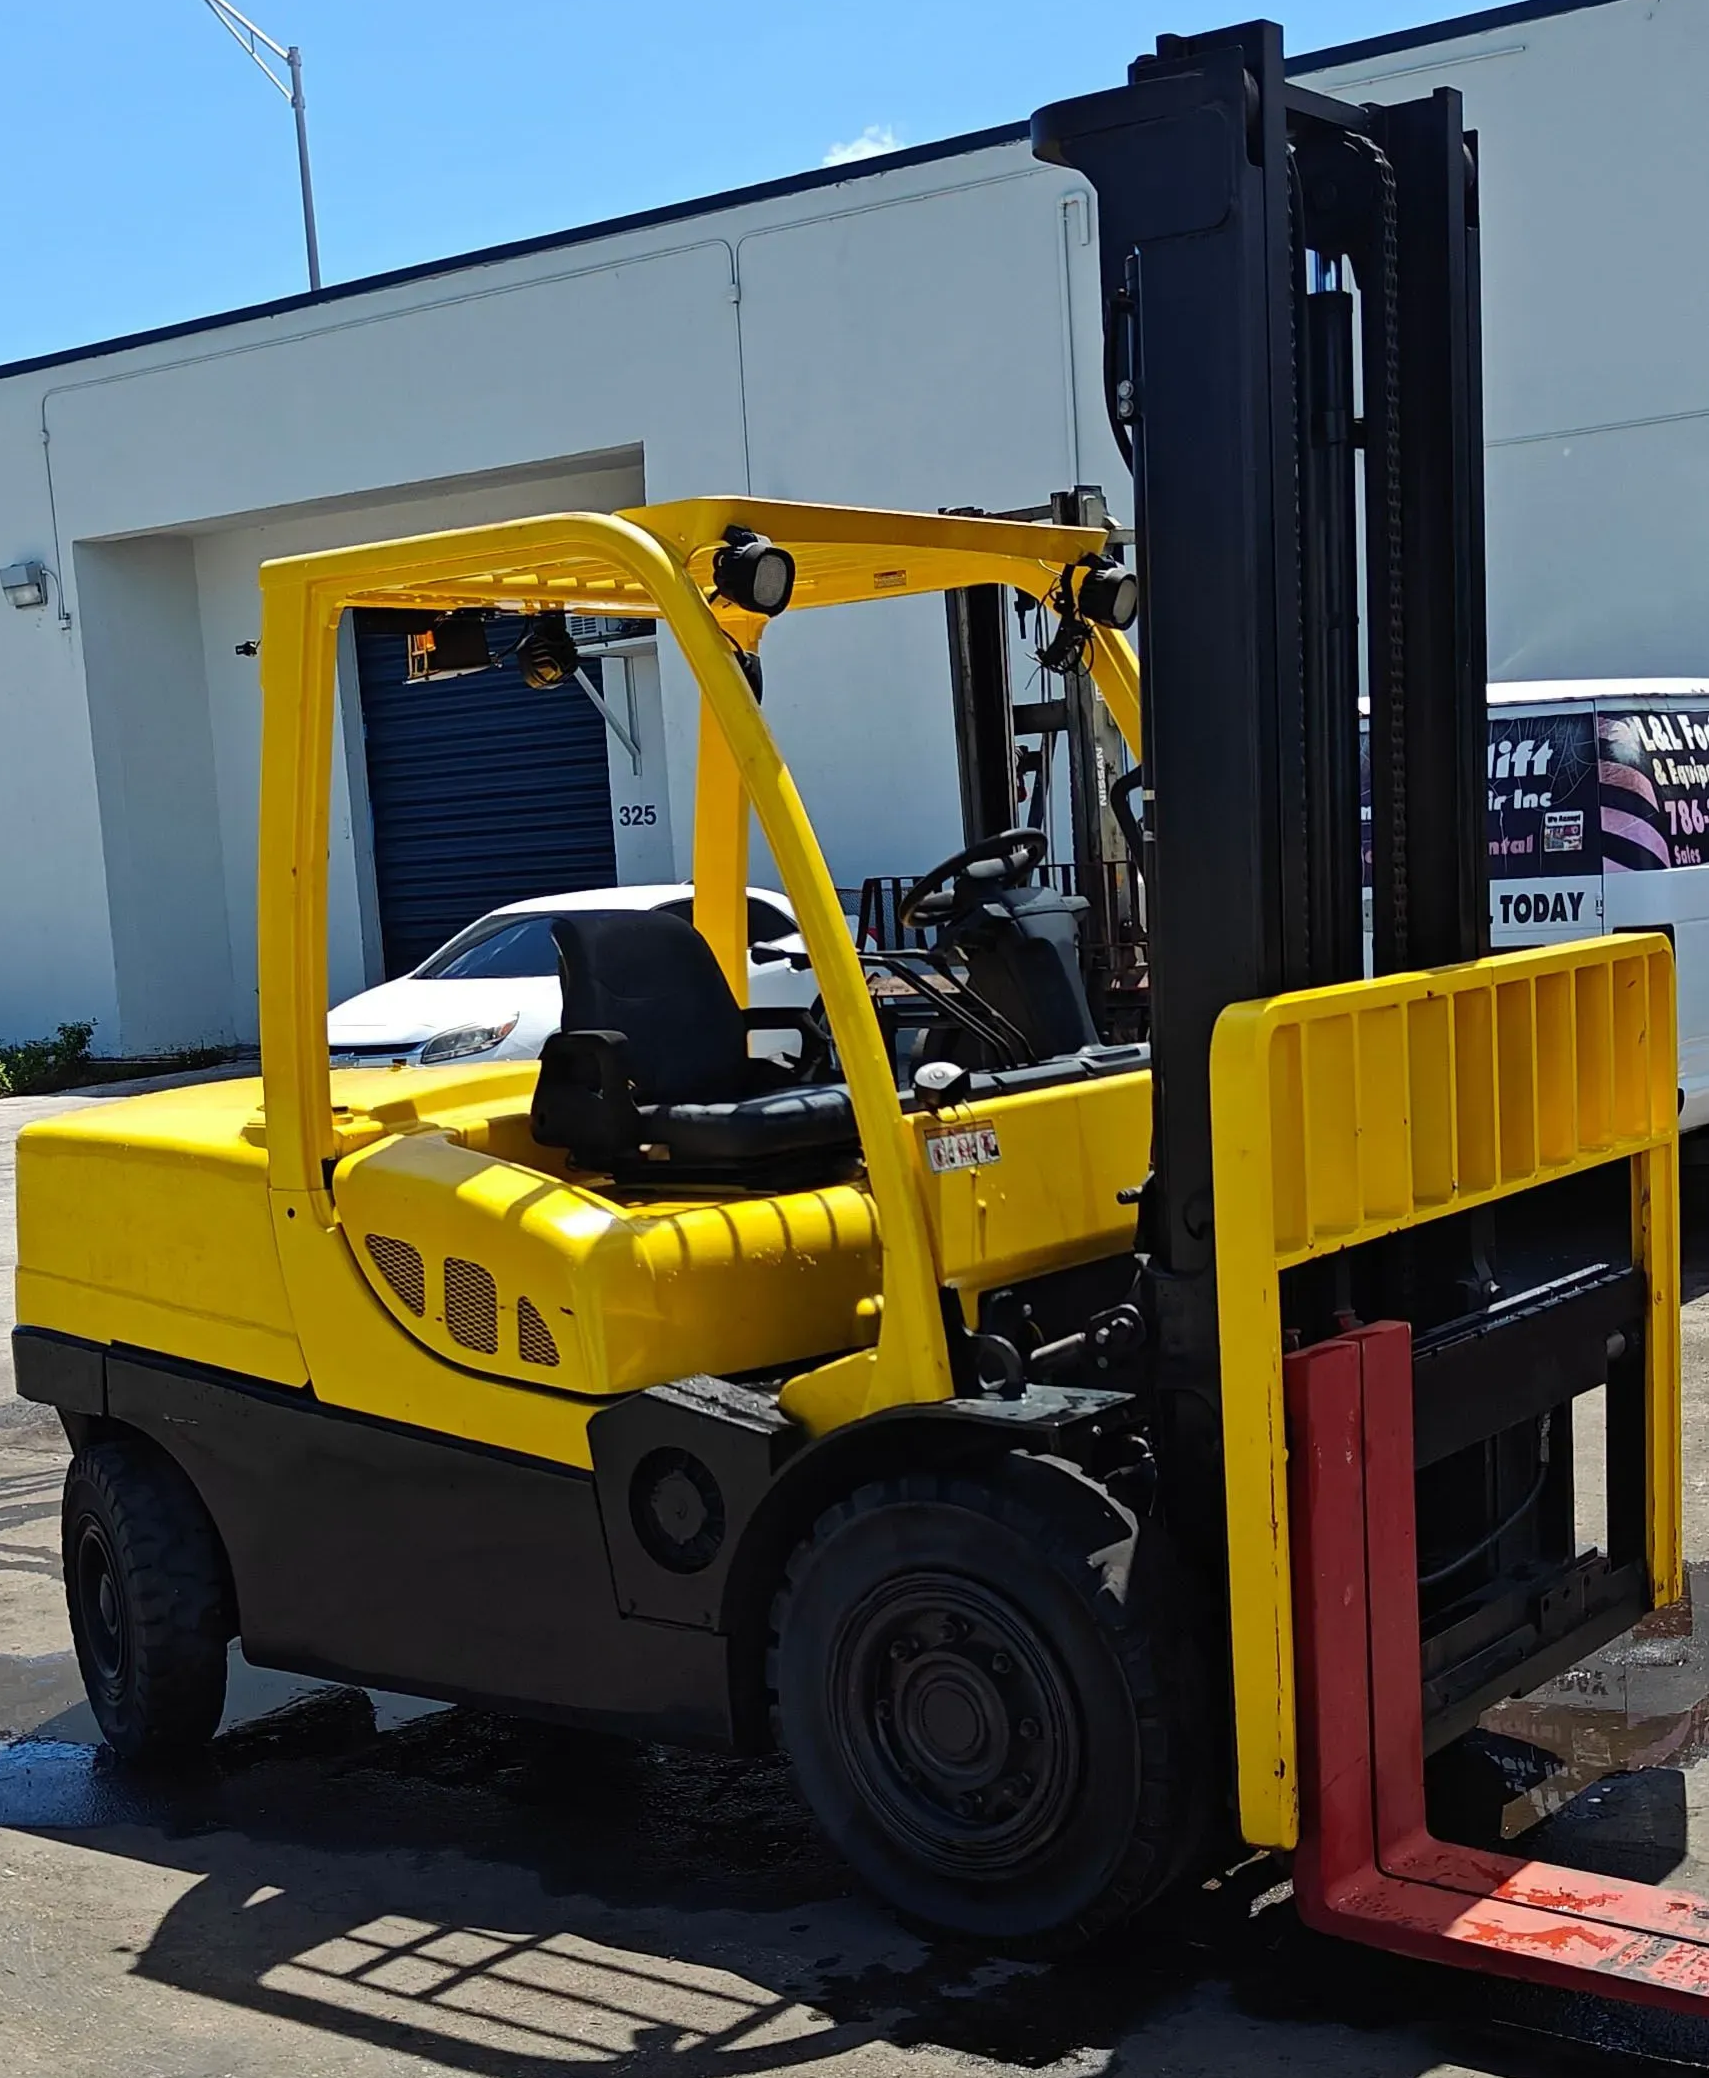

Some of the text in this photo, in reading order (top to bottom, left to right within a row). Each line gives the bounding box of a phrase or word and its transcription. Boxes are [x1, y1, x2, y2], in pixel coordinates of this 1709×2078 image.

[1632, 714, 1683, 751] L&L
[1095, 747, 1107, 807] NISSAN
[1652, 756, 1709, 790] & Equip
[619, 804, 657, 826] 325
[1513, 789, 1552, 808] Inc
[1664, 799, 1709, 835] 786-
[1674, 844, 1701, 865] Sales
[1500, 891, 1585, 924] TODAY
